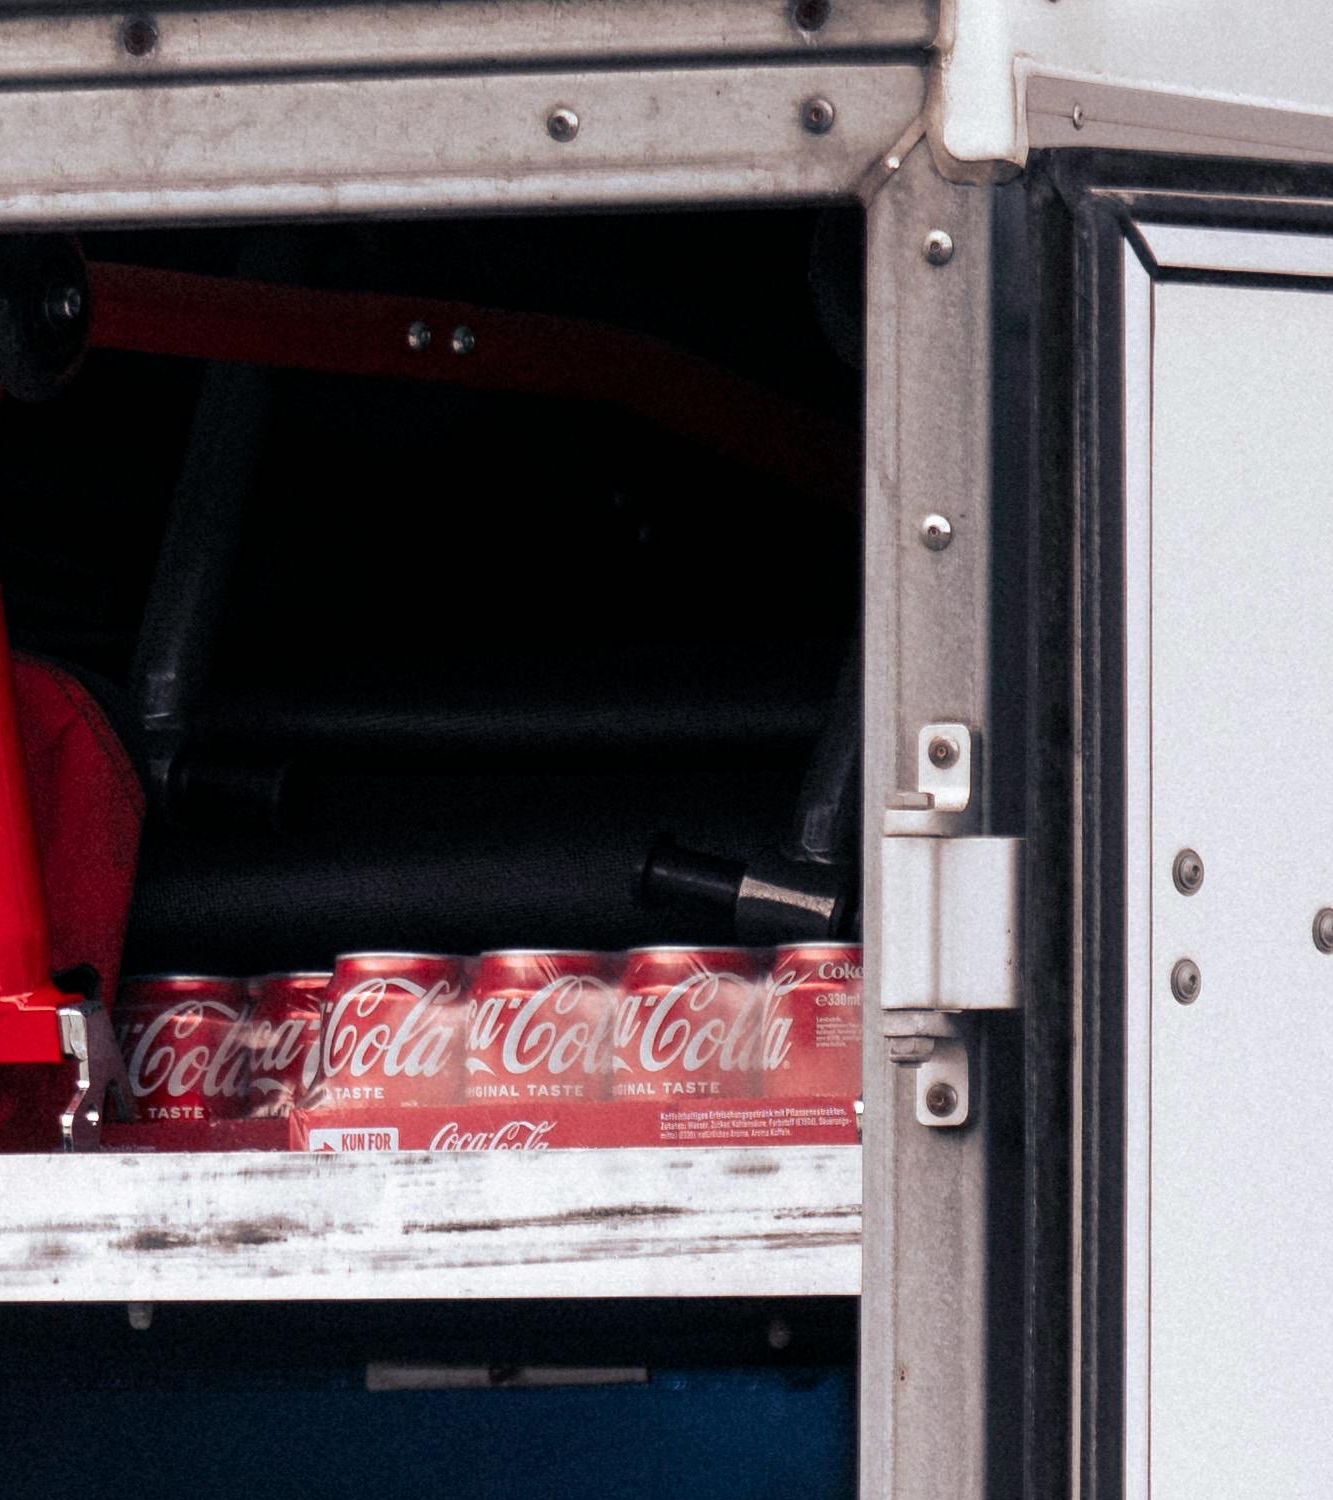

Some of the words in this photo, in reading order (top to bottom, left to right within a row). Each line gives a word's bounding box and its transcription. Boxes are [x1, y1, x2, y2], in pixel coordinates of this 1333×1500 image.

[334, 1087, 384, 1100] TASTE
[526, 1083, 584, 1098] TASTE
[663, 1081, 721, 1095] TASTE
[148, 1106, 205, 1120] TASTE
[341, 1134, 369, 1151] KUN
[369, 1133, 392, 1150] FOR
